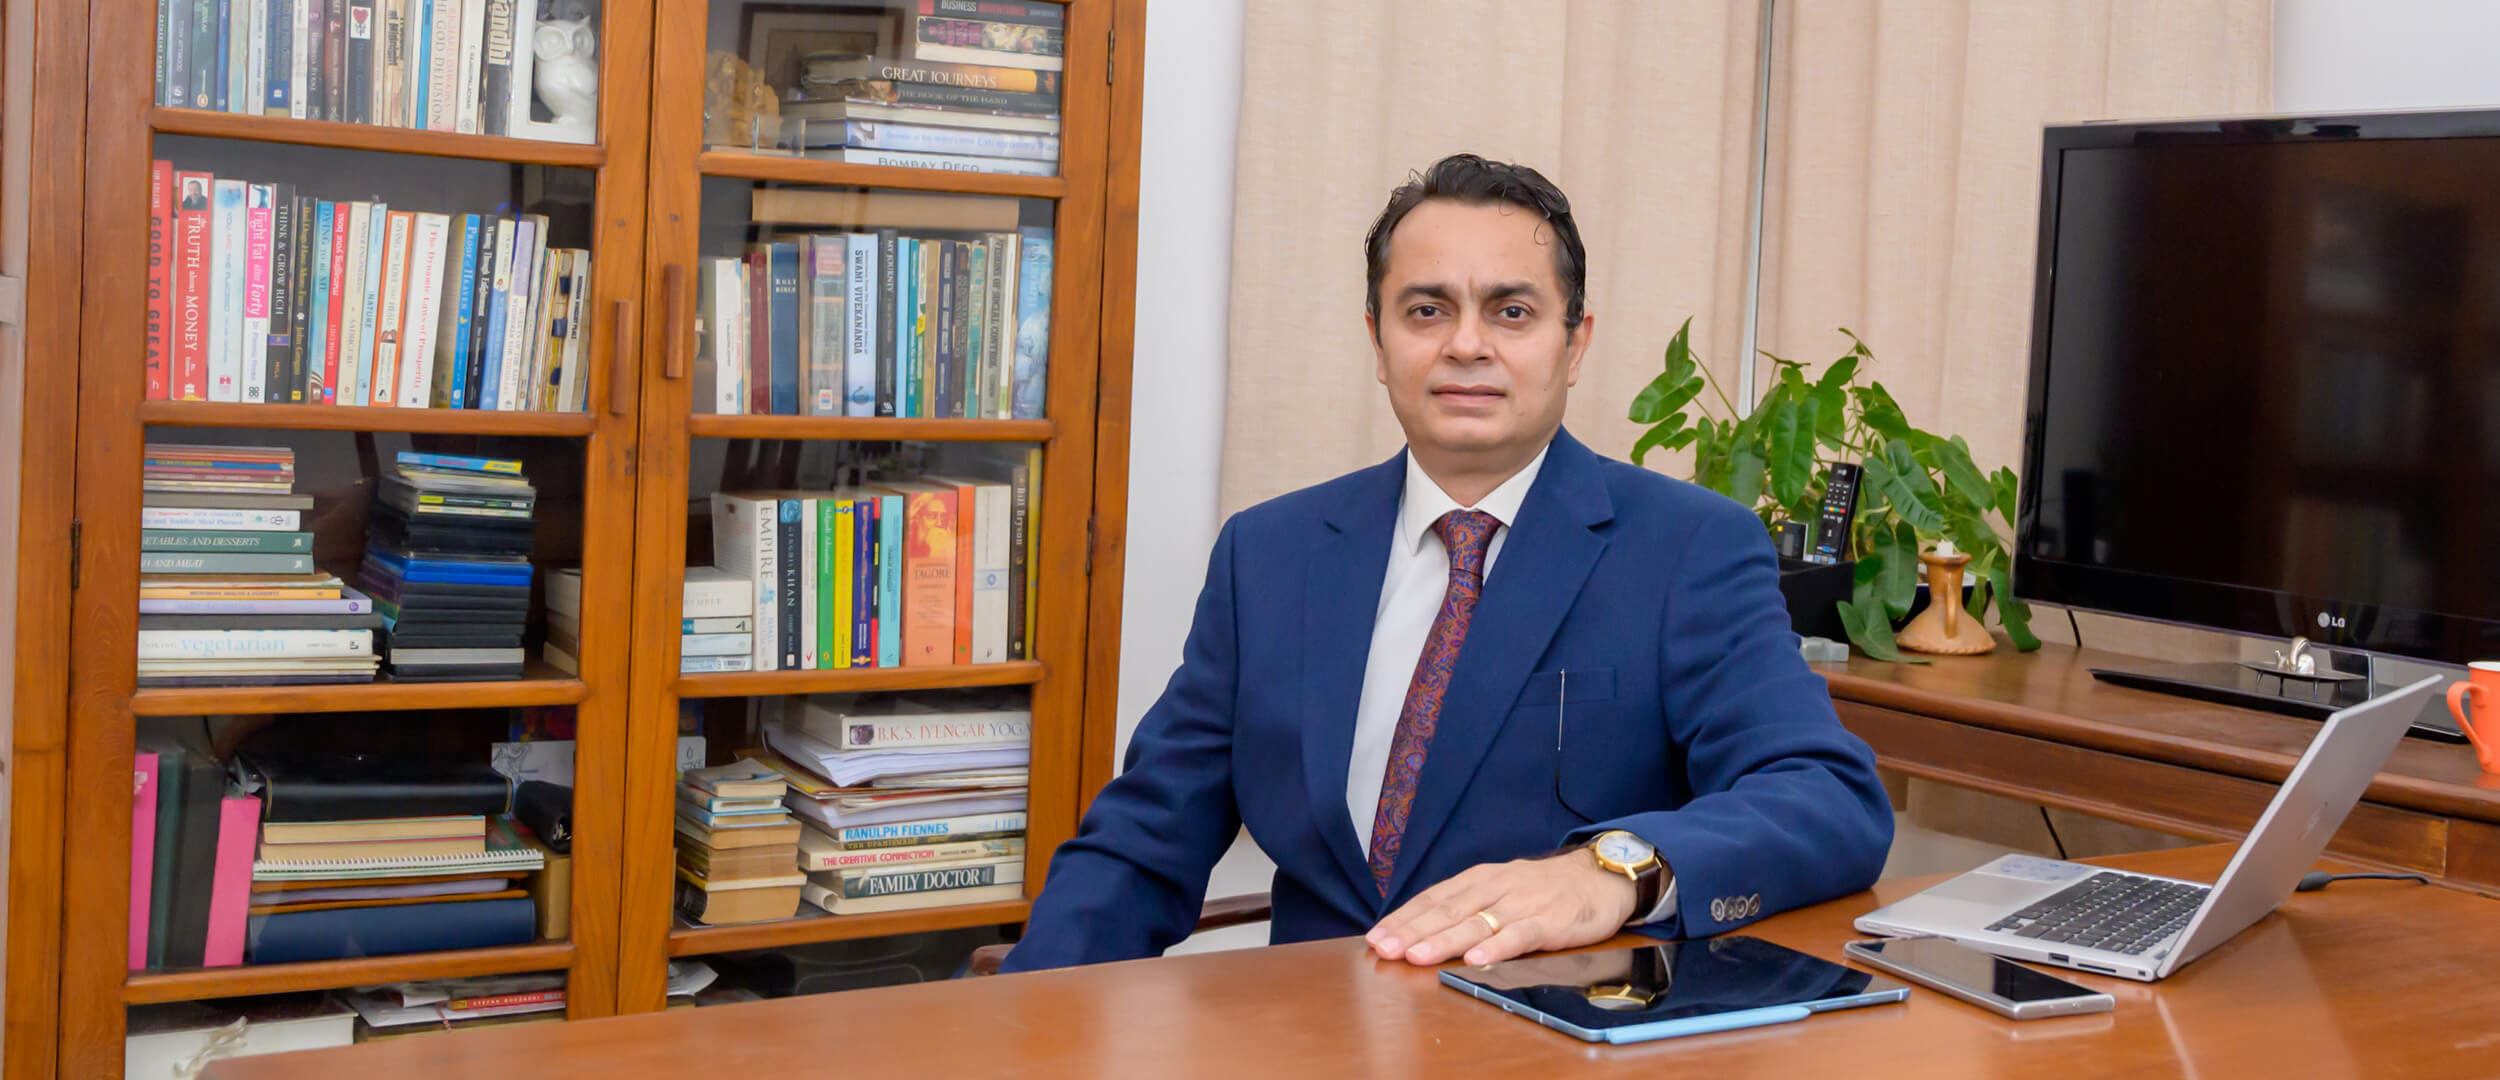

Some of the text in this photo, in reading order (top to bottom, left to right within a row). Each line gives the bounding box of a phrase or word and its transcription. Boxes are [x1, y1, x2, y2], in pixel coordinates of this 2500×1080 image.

[941, 0, 977, 12] BUSINESS
[435, 20, 446, 51] GOD
[432, 57, 445, 124] DELUSION
[881, 65, 997, 88] GREAT JOURNEYS
[878, 157, 936, 169] BOMBAY
[942, 161, 980, 172] DECO
[321, 208, 331, 245] DYING
[336, 213, 344, 232] boss
[187, 214, 200, 268] TRUTH
[428, 231, 437, 249] The
[887, 240, 894, 252] MY
[249, 211, 267, 315] Fight Fat after Forty
[275, 204, 288, 315] THINK & GROW RICH
[332, 255, 342, 296] managing
[423, 250, 436, 293] Dynamic
[886, 254, 894, 292] JOURNEY
[148, 217, 162, 371] GOOD TO GREAT
[420, 296, 431, 323] Laws
[854, 250, 864, 355] SWAMI VIVEKANANDA
[991, 291, 1000, 324] SOCIAL
[185, 295, 198, 352] MONEY
[364, 294, 375, 329] NATURE
[295, 326, 304, 344] John
[989, 326, 998, 369] CONTROL
[413, 337, 426, 389] Prosperity
[1015, 487, 1025, 545] Bill Bryson
[143, 537, 260, 546] ETABLES AND DESSERTS
[760, 507, 773, 579] EMPIRE
[787, 569, 795, 607] KHAN
[2331, 616, 2346, 627] LG
[180, 634, 286, 656] vegetarian
[878, 726, 916, 740] B.K.S.
[920, 724, 985, 739] IYENGAR
[845, 822, 949, 841] RANULPH FIENNES
[823, 857, 837, 866] THE
[838, 854, 876, 865] CREATIVE
[880, 850, 935, 862] CONNECTION
[869, 868, 980, 895] FAMILY DOCTOR
